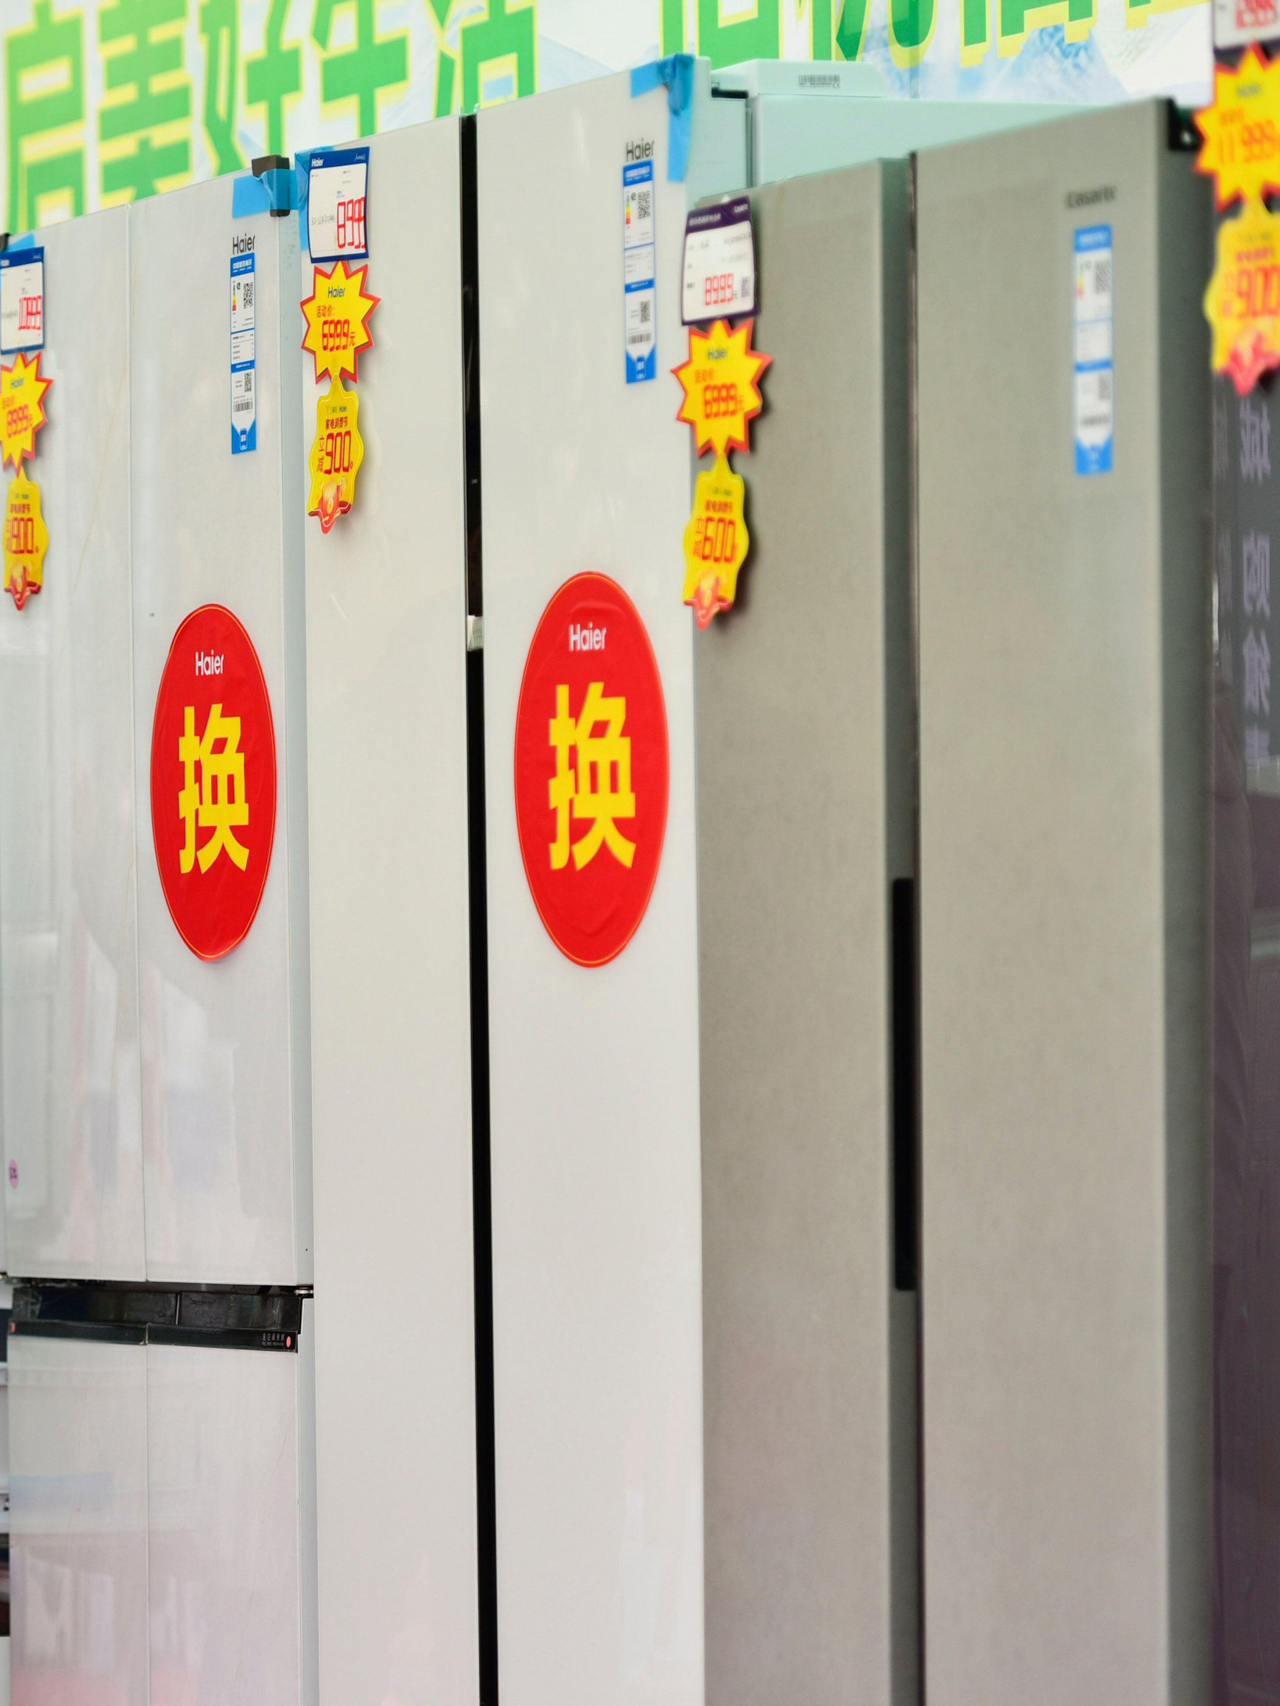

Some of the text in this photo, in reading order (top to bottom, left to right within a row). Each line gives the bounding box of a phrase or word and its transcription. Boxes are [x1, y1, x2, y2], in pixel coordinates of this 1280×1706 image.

[626, 138, 655, 162] Haier
[232, 233, 256, 255] Haier
[327, 285, 346, 298] Haier
[569, 622, 607, 652] Haier
[195, 650, 224, 676] Haier
[178, 703, 250, 875] 换
[549, 682, 637, 871] 换
